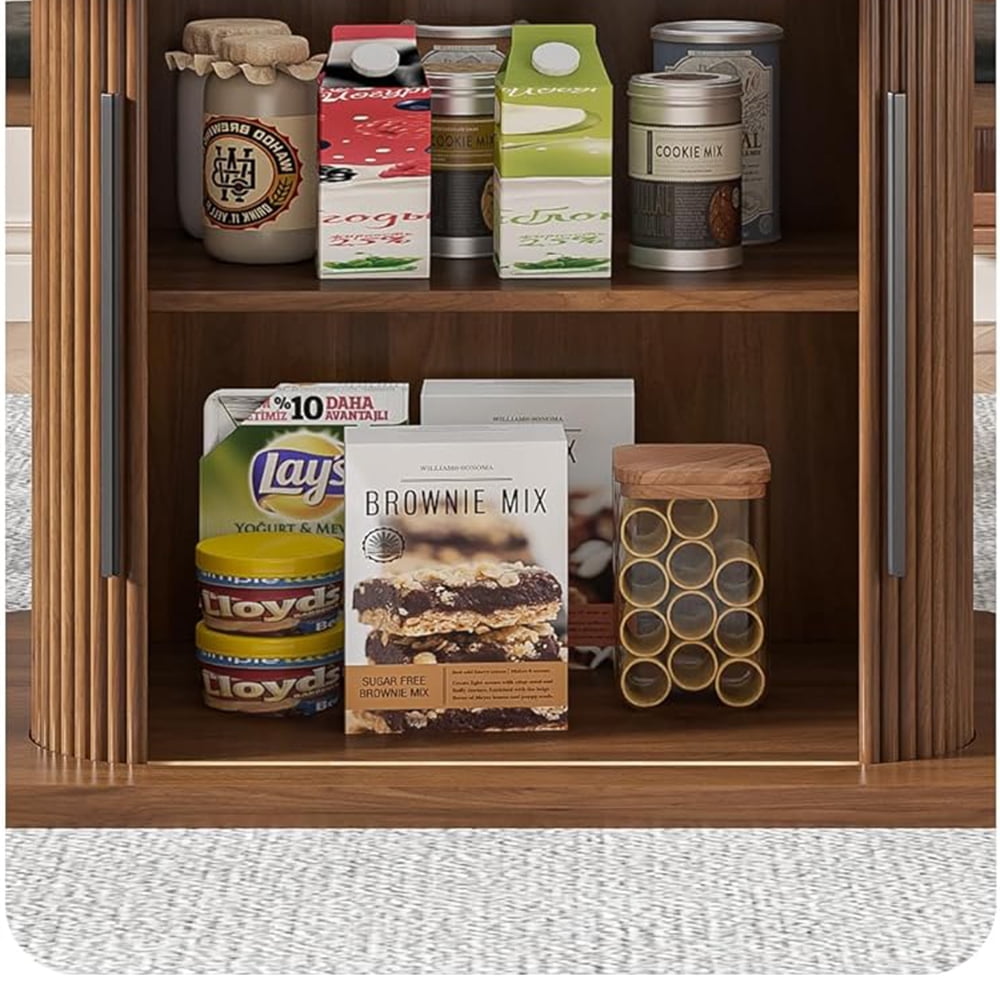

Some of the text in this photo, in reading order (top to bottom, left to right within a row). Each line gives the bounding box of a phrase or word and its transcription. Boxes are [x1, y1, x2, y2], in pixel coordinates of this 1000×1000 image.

[655, 144, 723, 158] COOKIE MIX
[326, 396, 373, 410] DAHA
[325, 410, 388, 422] AVANTAJLI
[365, 488, 547, 517] BROWNIE MIX
[362, 675, 426, 687] SUGAR FREE
[360, 687, 429, 698] BROWNIE MIX
